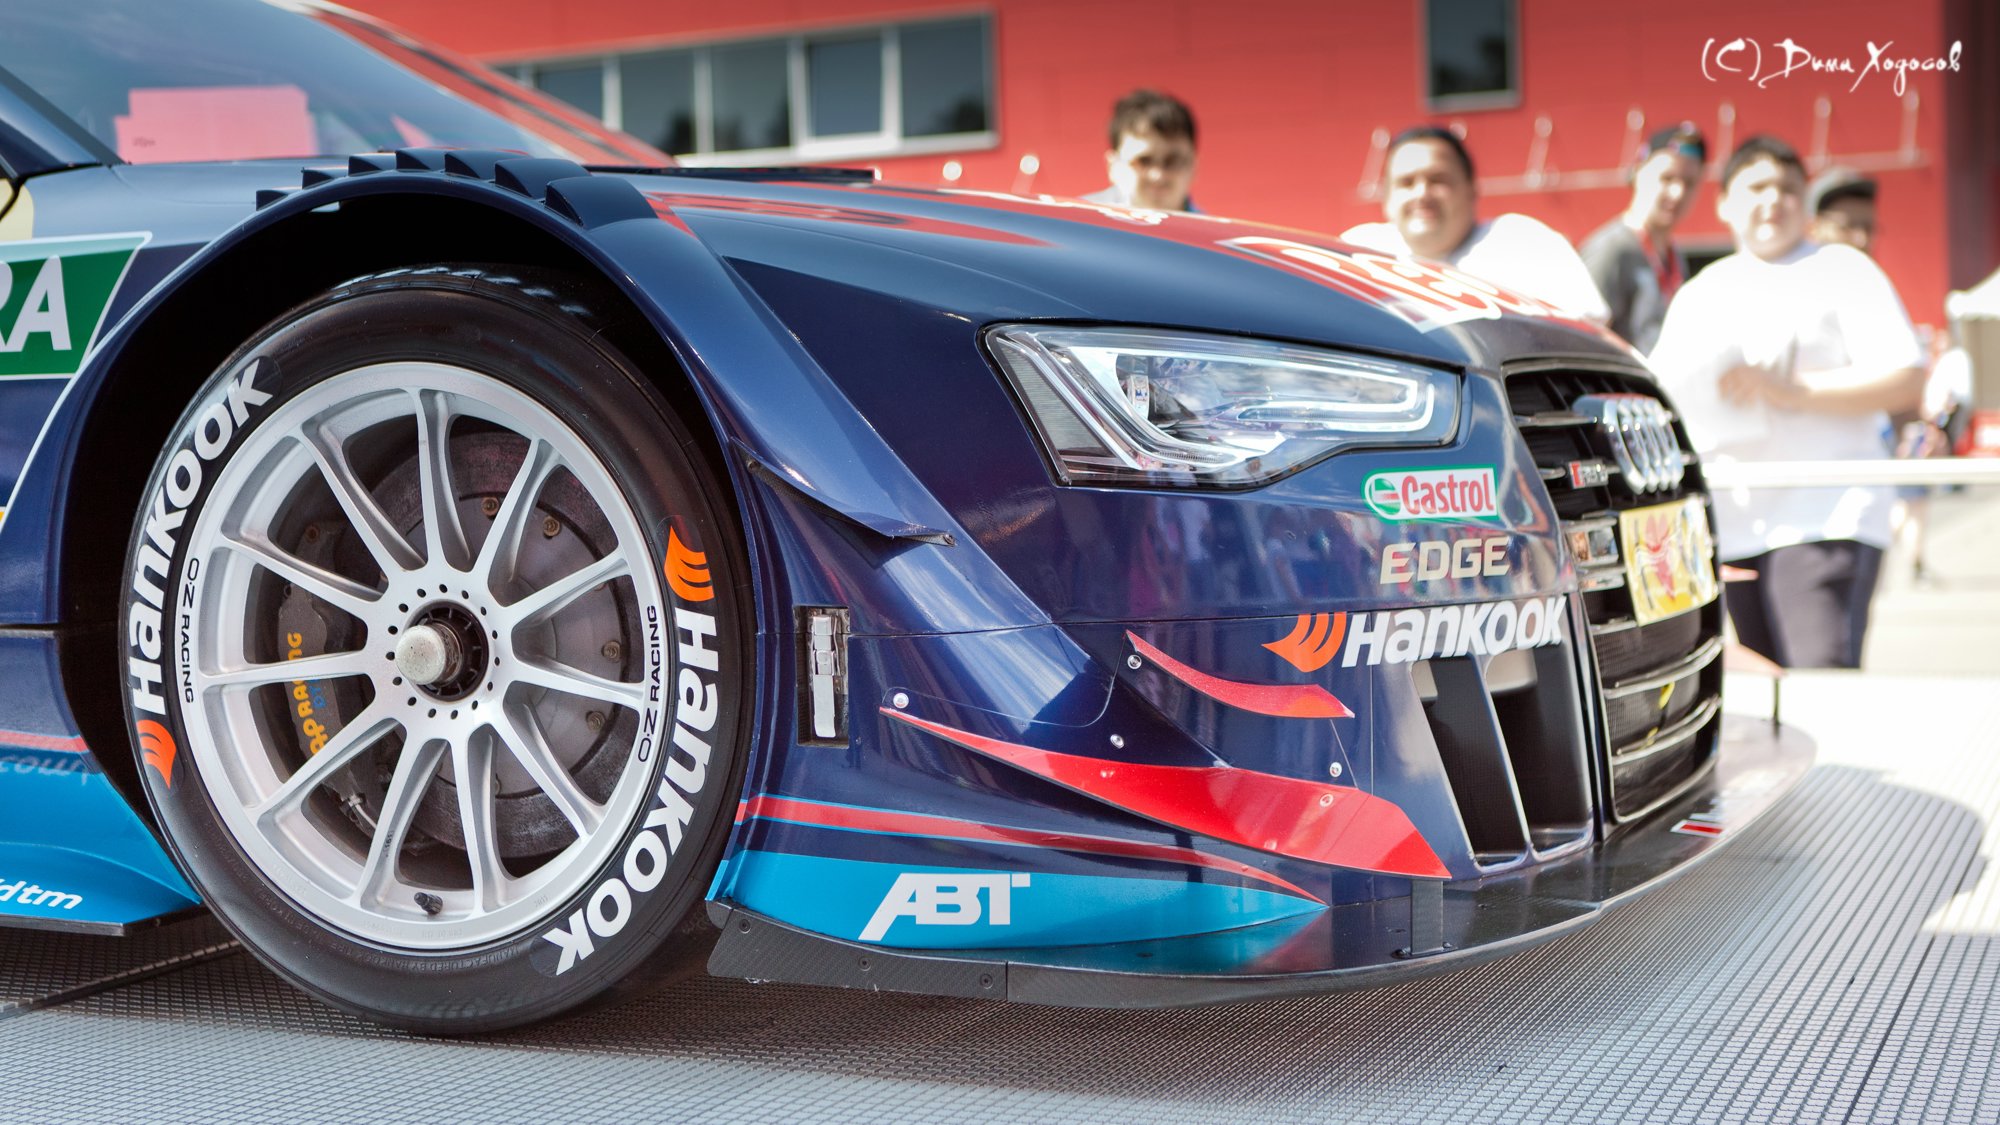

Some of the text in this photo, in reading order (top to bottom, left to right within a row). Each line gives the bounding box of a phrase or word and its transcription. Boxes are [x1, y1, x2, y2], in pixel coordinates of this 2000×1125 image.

[1401, 473, 1495, 515] Castrol
[1380, 536, 1511, 585] EDGE
[181, 613, 194, 704] RACING
[646, 604, 661, 702] RACING
[858, 873, 1031, 941] ABT
